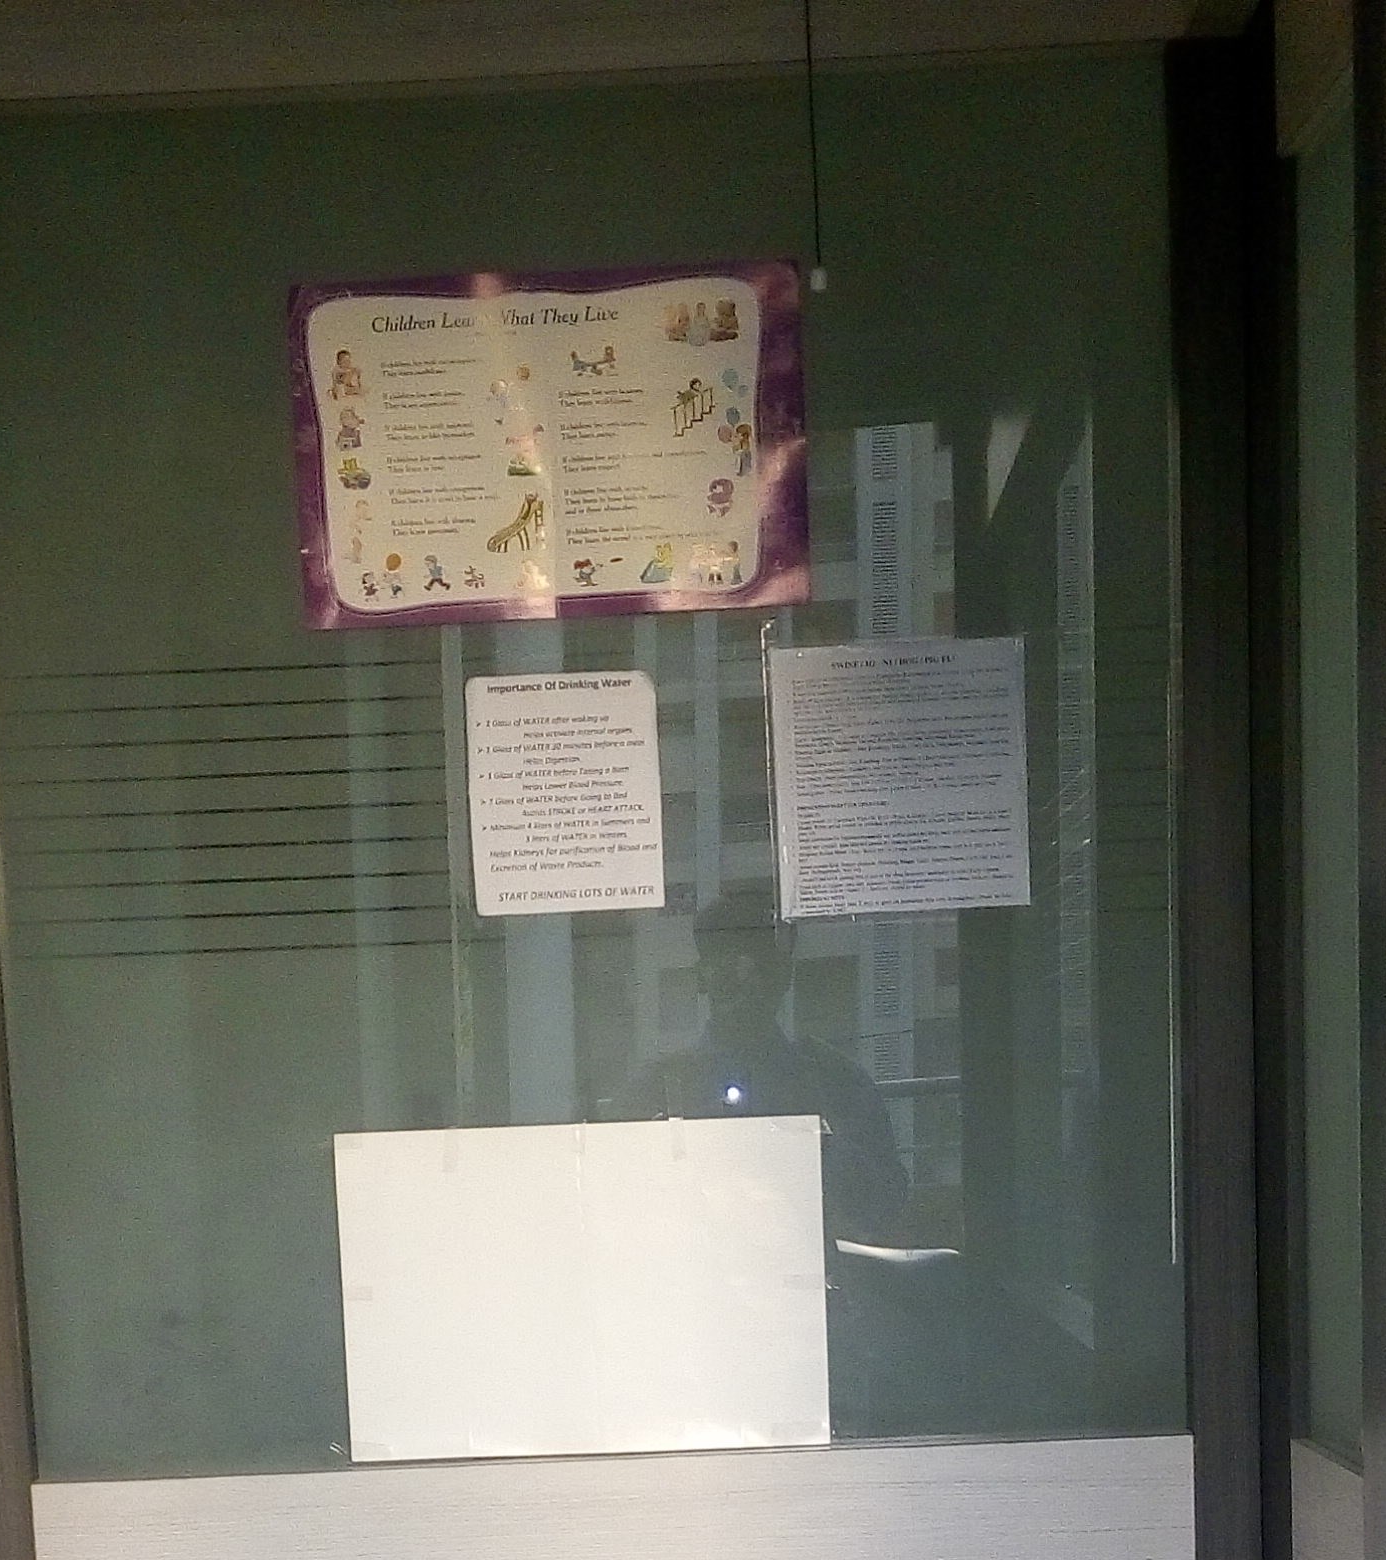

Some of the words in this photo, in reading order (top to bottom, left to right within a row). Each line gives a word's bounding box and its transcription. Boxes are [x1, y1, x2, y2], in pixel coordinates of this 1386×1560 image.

[371, 312, 435, 333] Children
[541, 307, 579, 325] They
[584, 305, 619, 323] Live
[487, 682, 542, 695] Importance
[544, 680, 556, 691] Of
[558, 679, 599, 691] Drinking
[601, 678, 632, 689] Water
[523, 716, 550, 725] WATER
[523, 743, 550, 752] WATER
[526, 795, 553, 804] WATER
[563, 819, 590, 828] WATER
[545, 847, 558, 858] for
[529, 862, 538, 872] of
[498, 891, 528, 902] START
[530, 889, 577, 900] DRINKING
[579, 888, 602, 898] LOTS
[604, 887, 616, 897] OF
[620, 885, 655, 896] WATER
